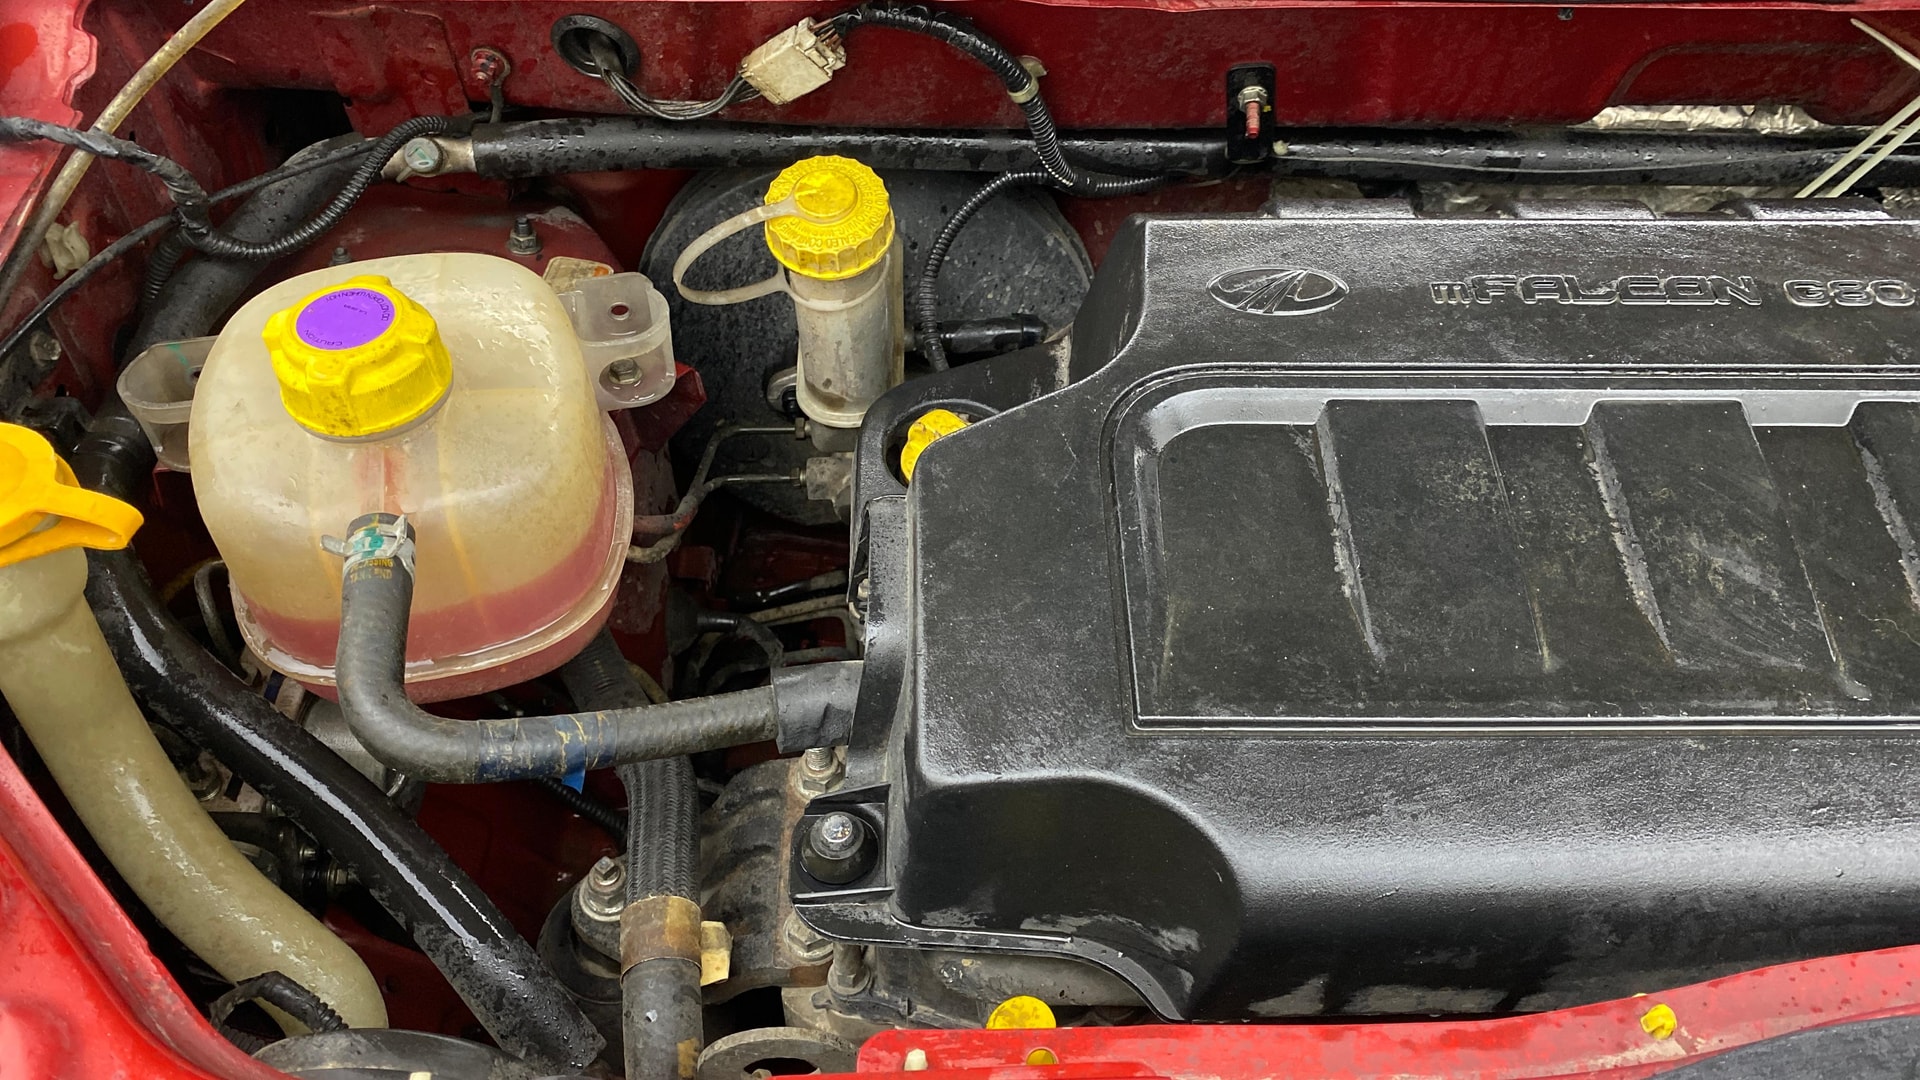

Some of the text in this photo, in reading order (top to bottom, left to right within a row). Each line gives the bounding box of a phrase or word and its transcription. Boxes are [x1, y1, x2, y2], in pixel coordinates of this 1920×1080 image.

[864, 207, 885, 230] FROM
[825, 230, 864, 248] SEALED
[1430, 274, 1916, 306] mFALCON G80
[304, 329, 343, 346] CAUTION
